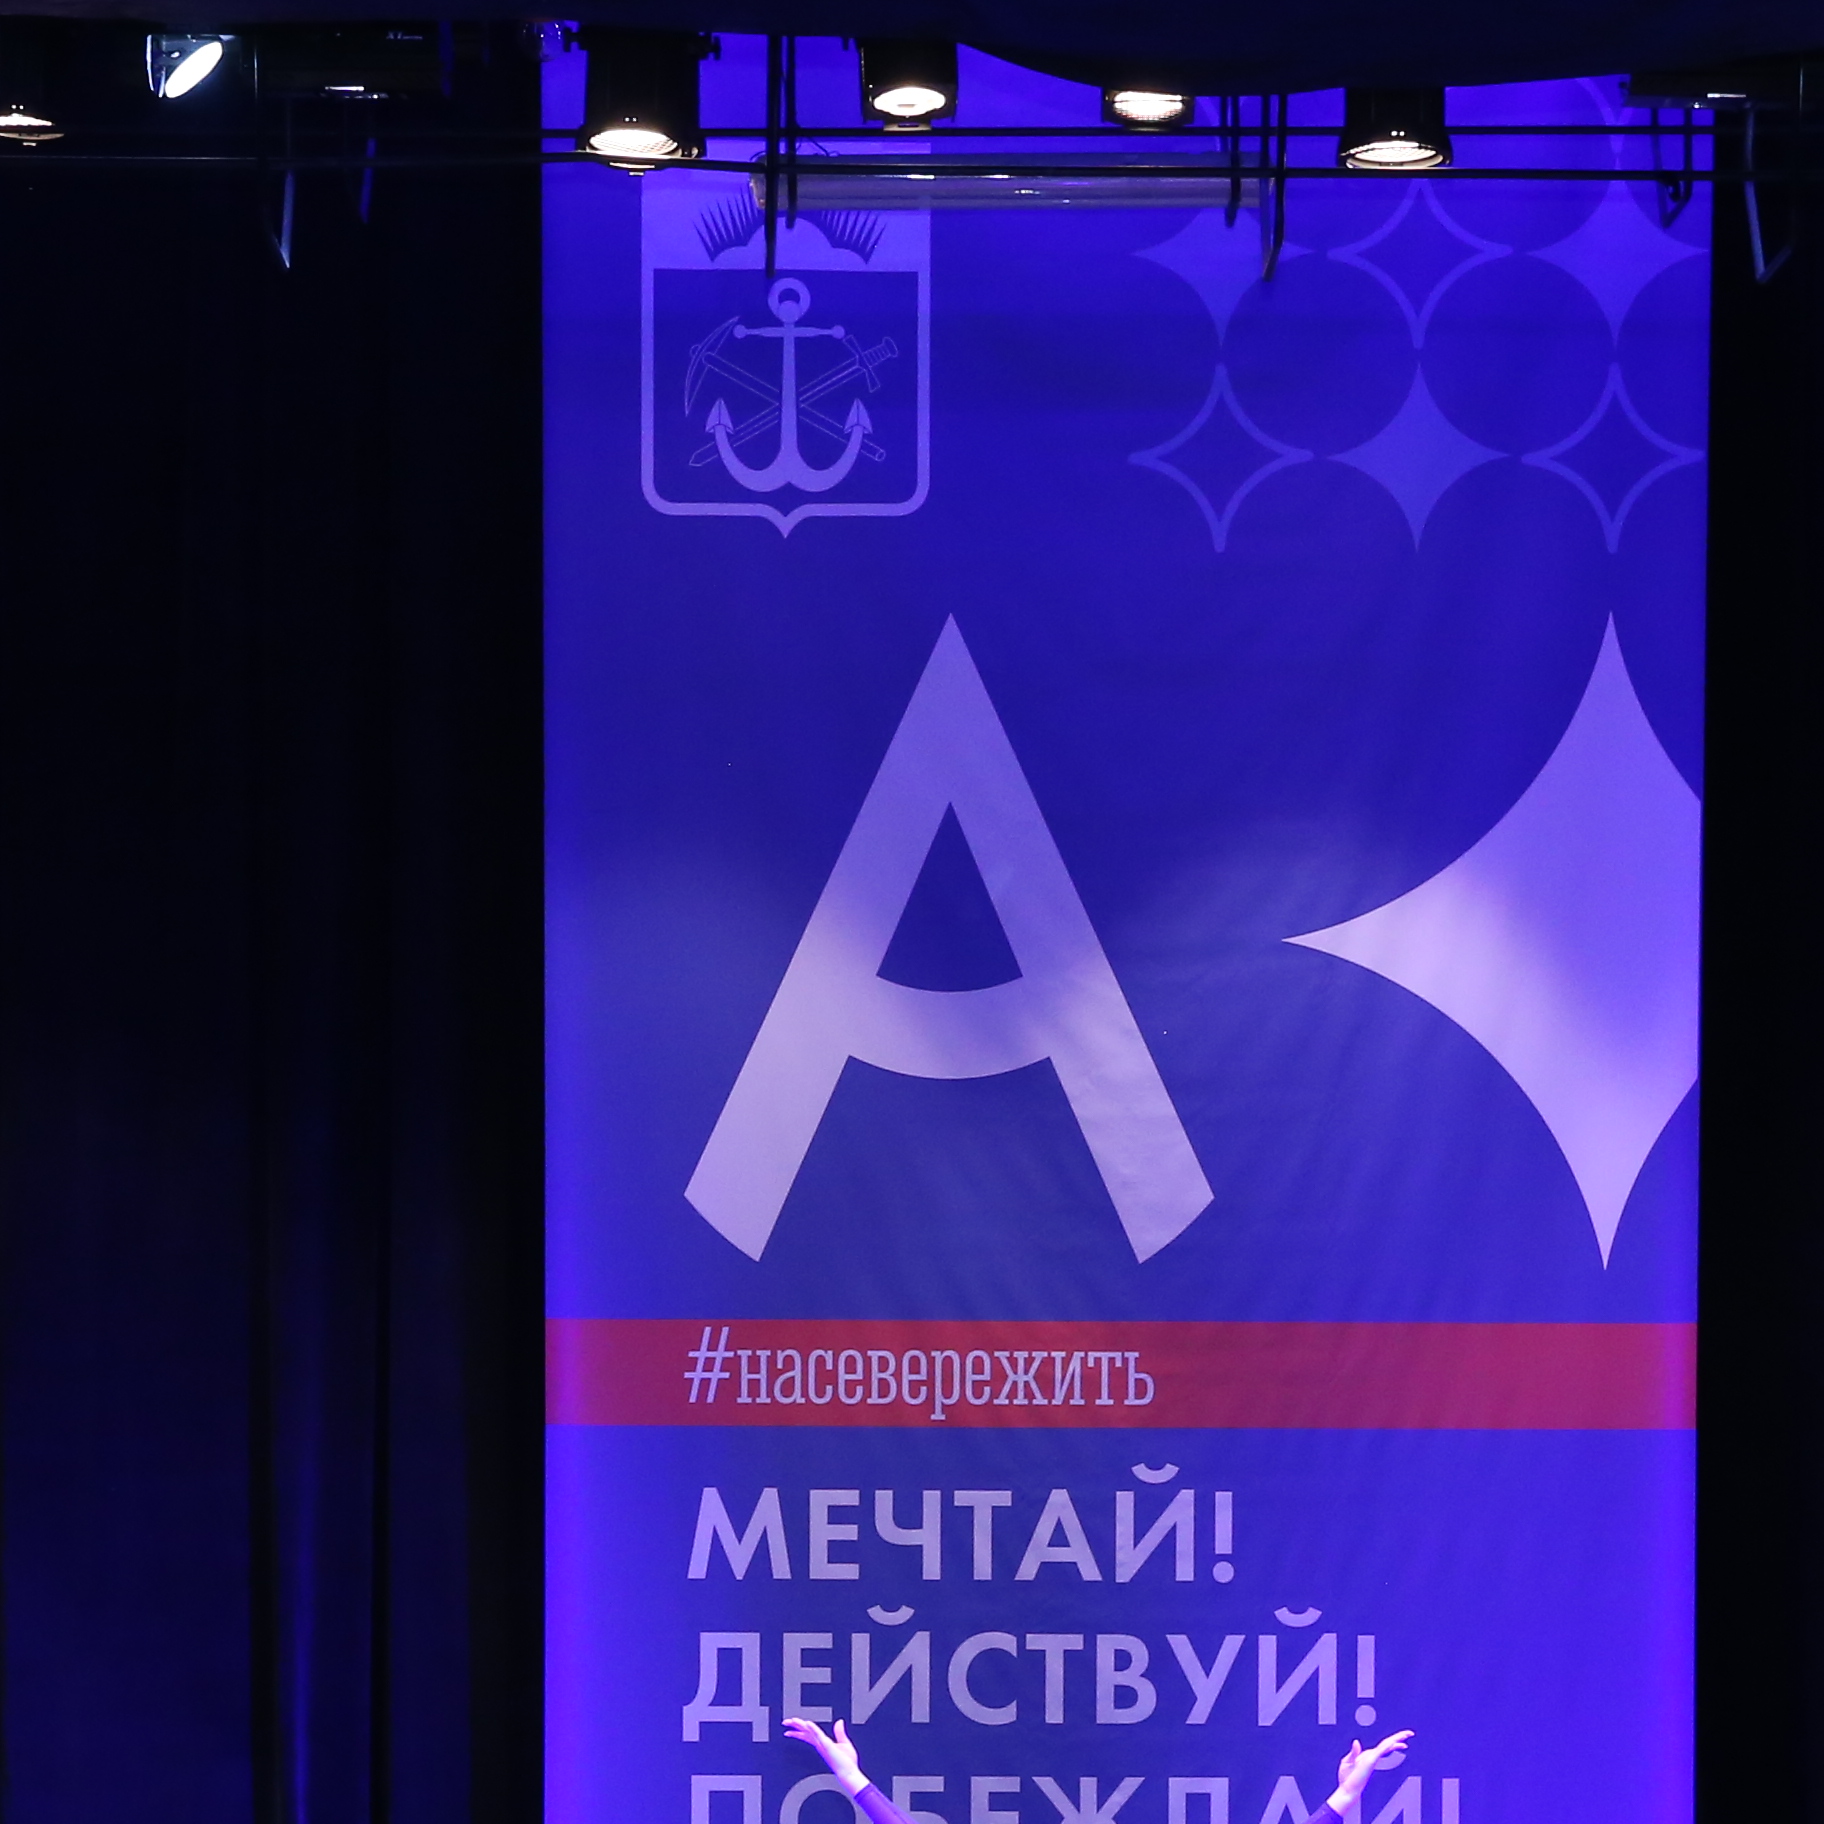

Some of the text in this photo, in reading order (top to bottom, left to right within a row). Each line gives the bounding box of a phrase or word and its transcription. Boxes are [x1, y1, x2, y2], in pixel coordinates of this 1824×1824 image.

[684, 1326, 1155, 1420] #насевережить
[687, 1463, 1236, 1583] МЕЧТАЙ!
[682, 1605, 1377, 1742] ДЕЙСТВУЙ!
